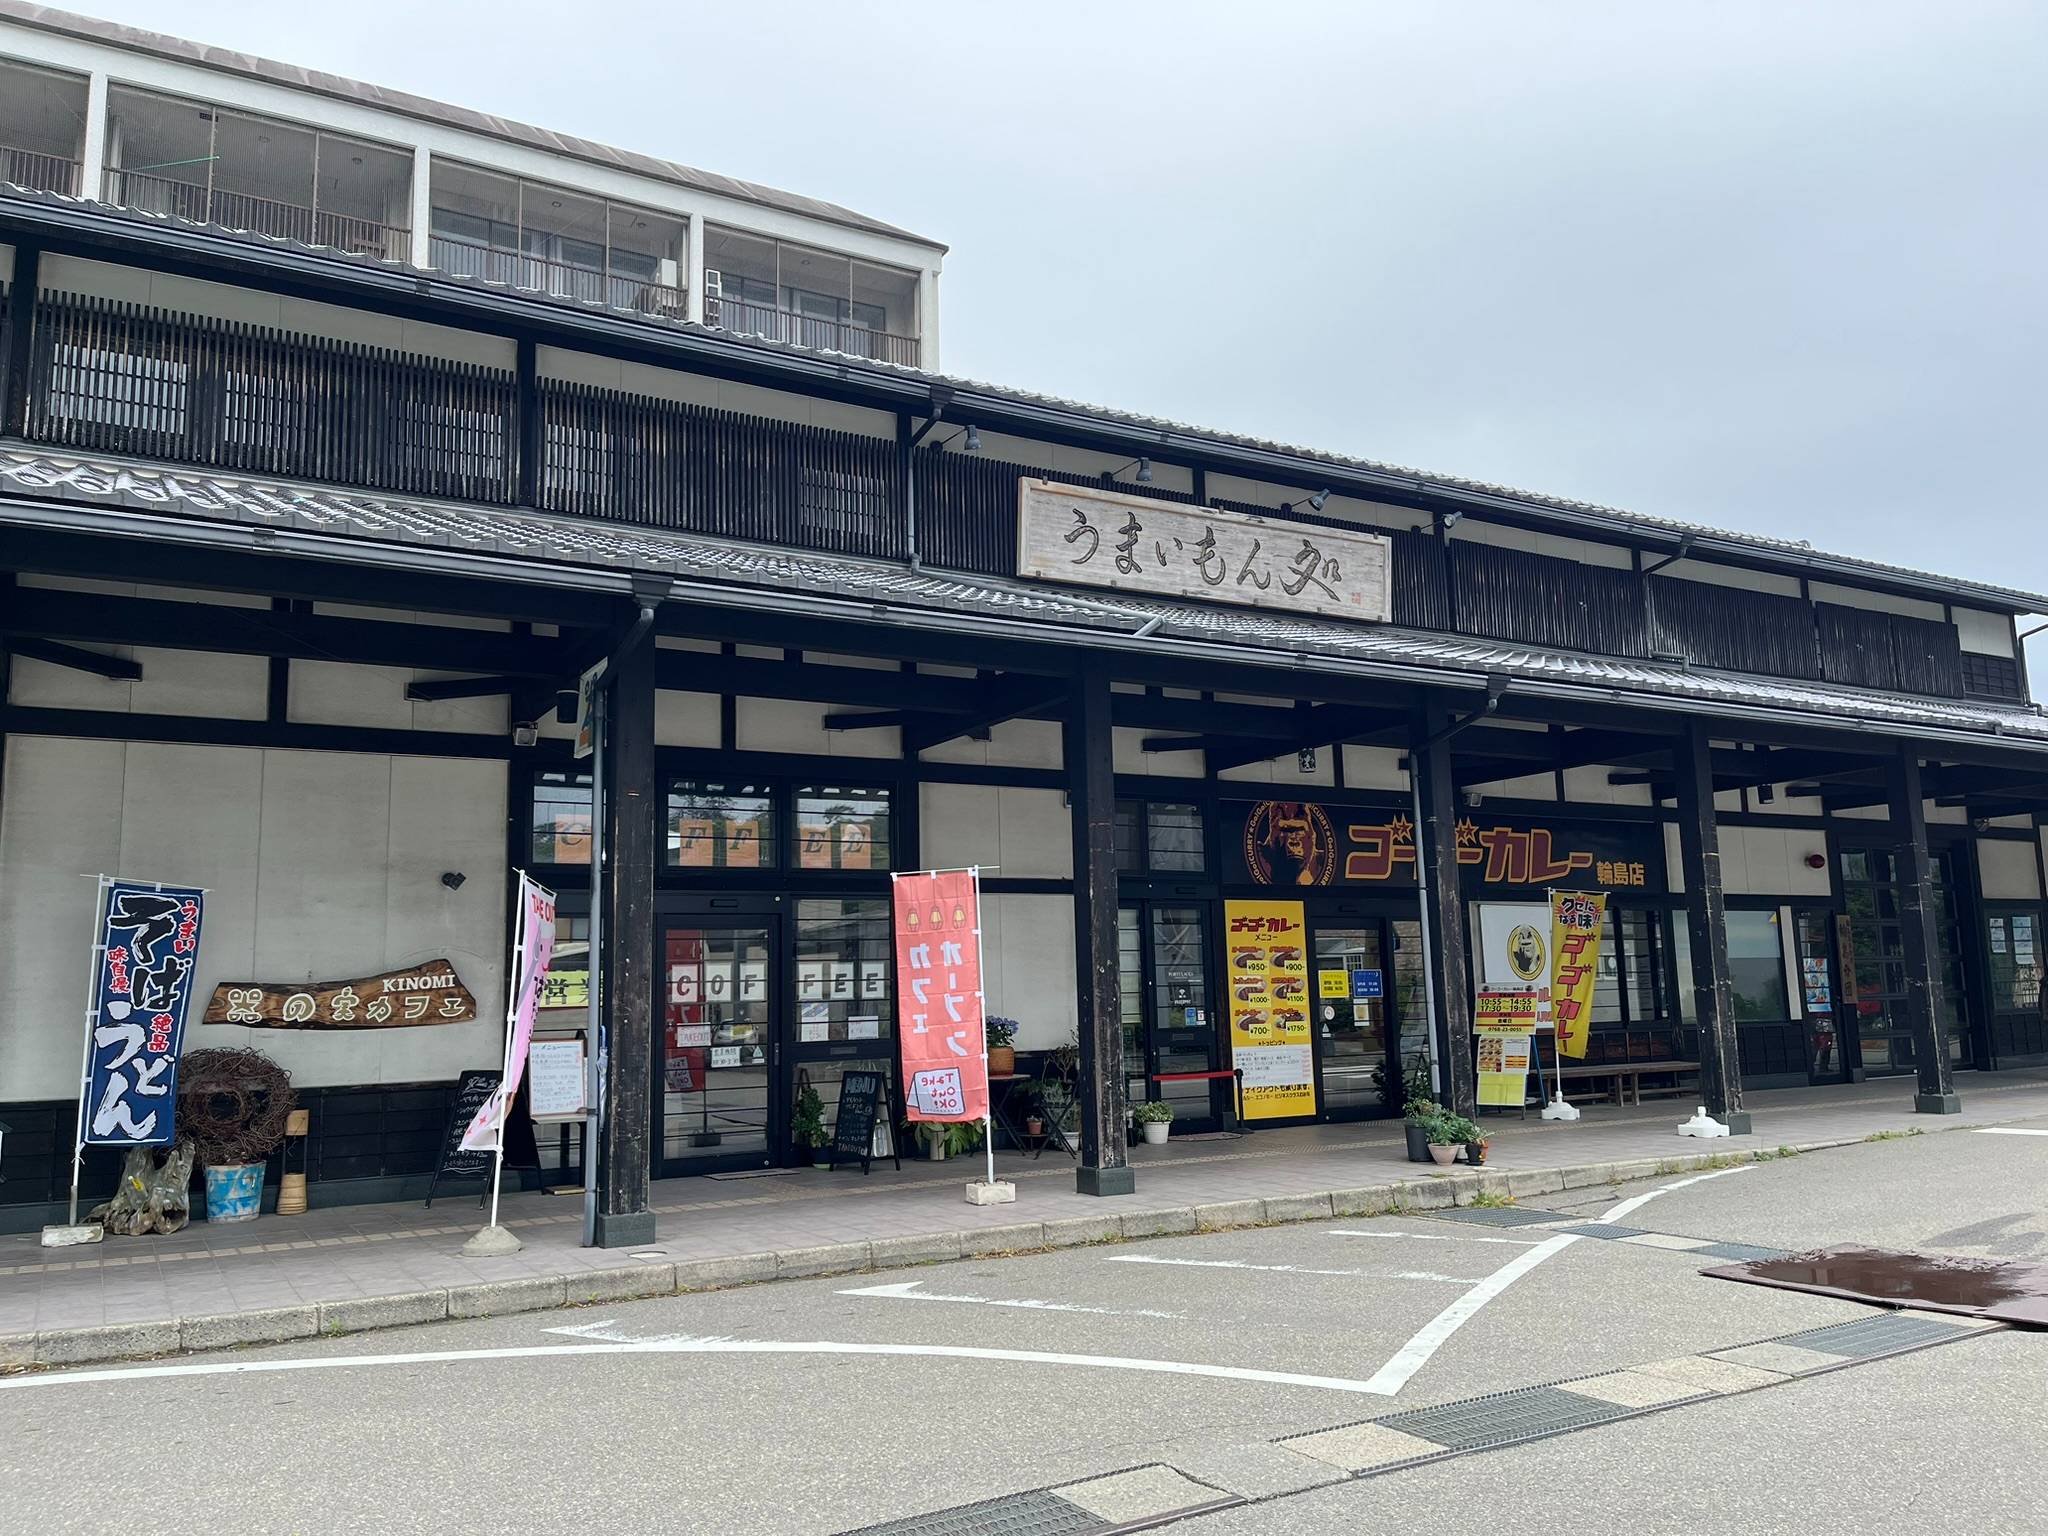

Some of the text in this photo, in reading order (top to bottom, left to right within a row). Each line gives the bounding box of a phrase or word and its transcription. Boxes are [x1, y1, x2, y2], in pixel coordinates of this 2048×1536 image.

[1064, 508, 1342, 602] うまいもん処
[560, 823, 867, 853] CFFEE
[1345, 812, 1645, 887] ゴーーカレー 輪島店
[174, 899, 198, 954] うまい
[1231, 916, 1300, 932] ゴーゴーカレー
[1561, 897, 1597, 913] クセに
[107, 894, 193, 1012] そば
[107, 945, 131, 994] 味自慢
[382, 974, 456, 993] KINOMI
[676, 972, 879, 997] COFFEE
[1556, 932, 1597, 1053] ゴーゴーカレー
[147, 1012, 174, 1053] 絶品
[92, 1000, 175, 1141] うどん
